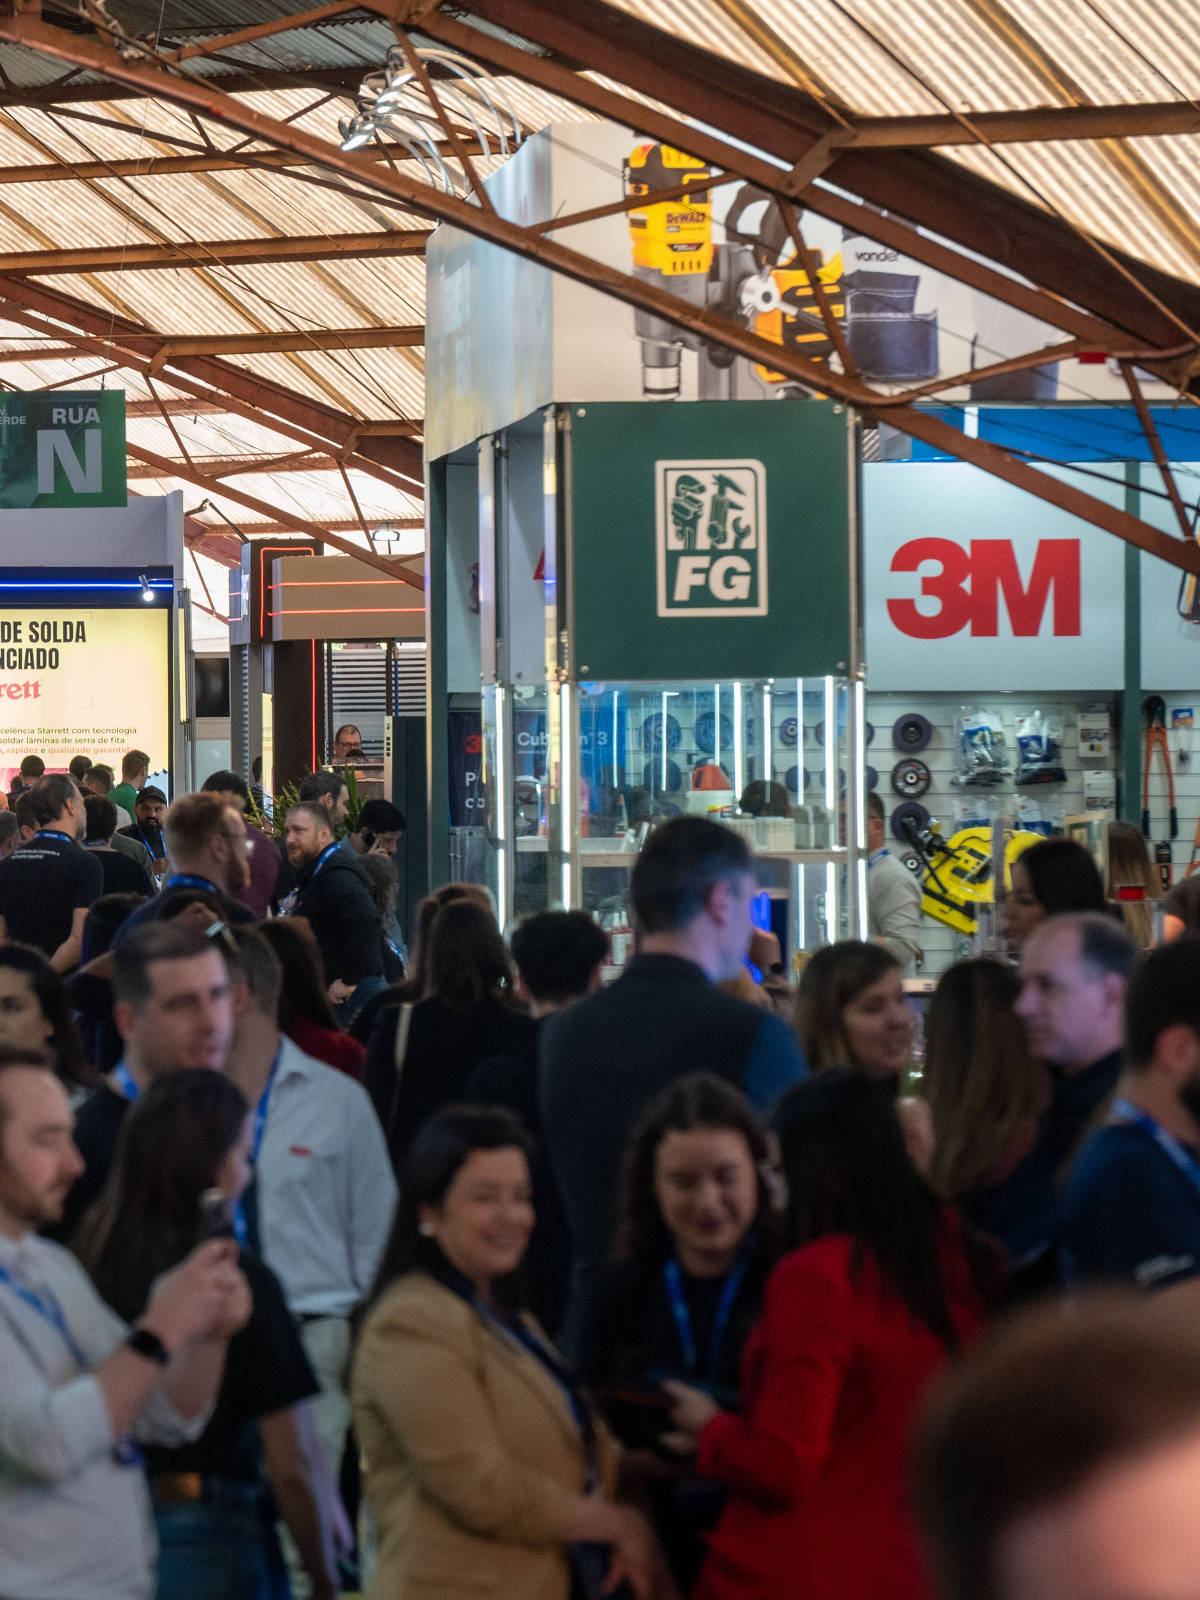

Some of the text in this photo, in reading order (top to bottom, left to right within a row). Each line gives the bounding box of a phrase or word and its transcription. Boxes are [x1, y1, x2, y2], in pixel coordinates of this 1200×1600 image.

[53, 407, 101, 424] RUA
[37, 429, 102, 494] N
[674, 555, 751, 601] FG
[886, 537, 1081, 640] 3M
[1, 621, 22, 643] DE
[29, 621, 86, 643] SOLDA
[37, 727, 69, 735] Starrett
[92, 727, 137, 736] tecnologia
[7, 747, 38, 755] rapidez
[47, 746, 91, 755] qualidade
[93, 746, 134, 756] garantid
